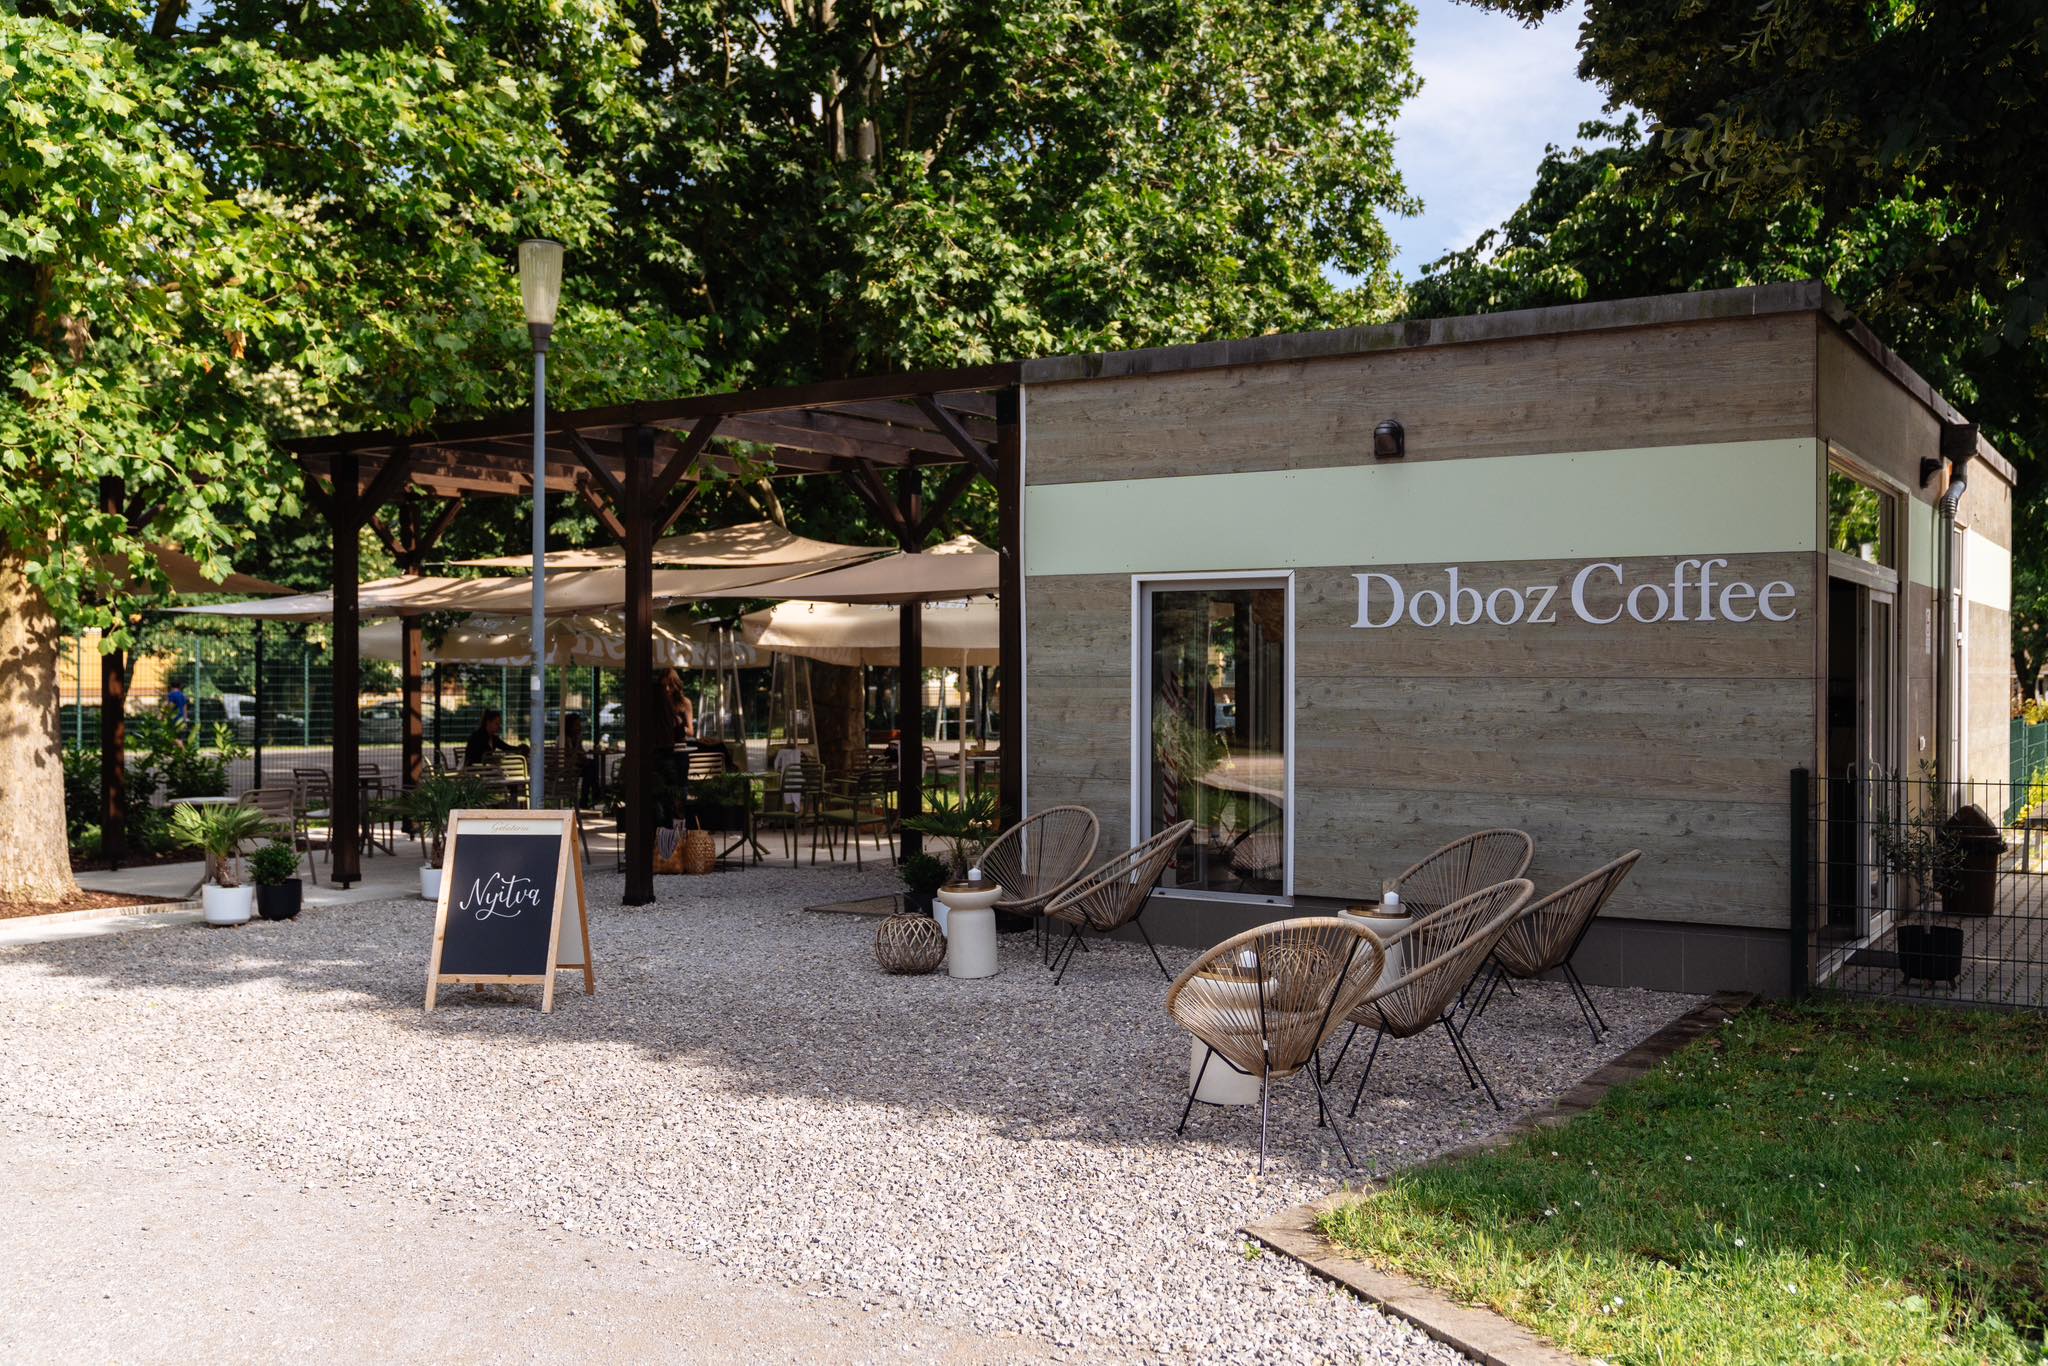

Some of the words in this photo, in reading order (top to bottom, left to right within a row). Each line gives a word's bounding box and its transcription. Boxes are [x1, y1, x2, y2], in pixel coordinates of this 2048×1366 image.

[1350, 566, 1559, 629] Doboz
[1571, 558, 1797, 625] Coffee
[459, 872, 541, 921] Nyitva
